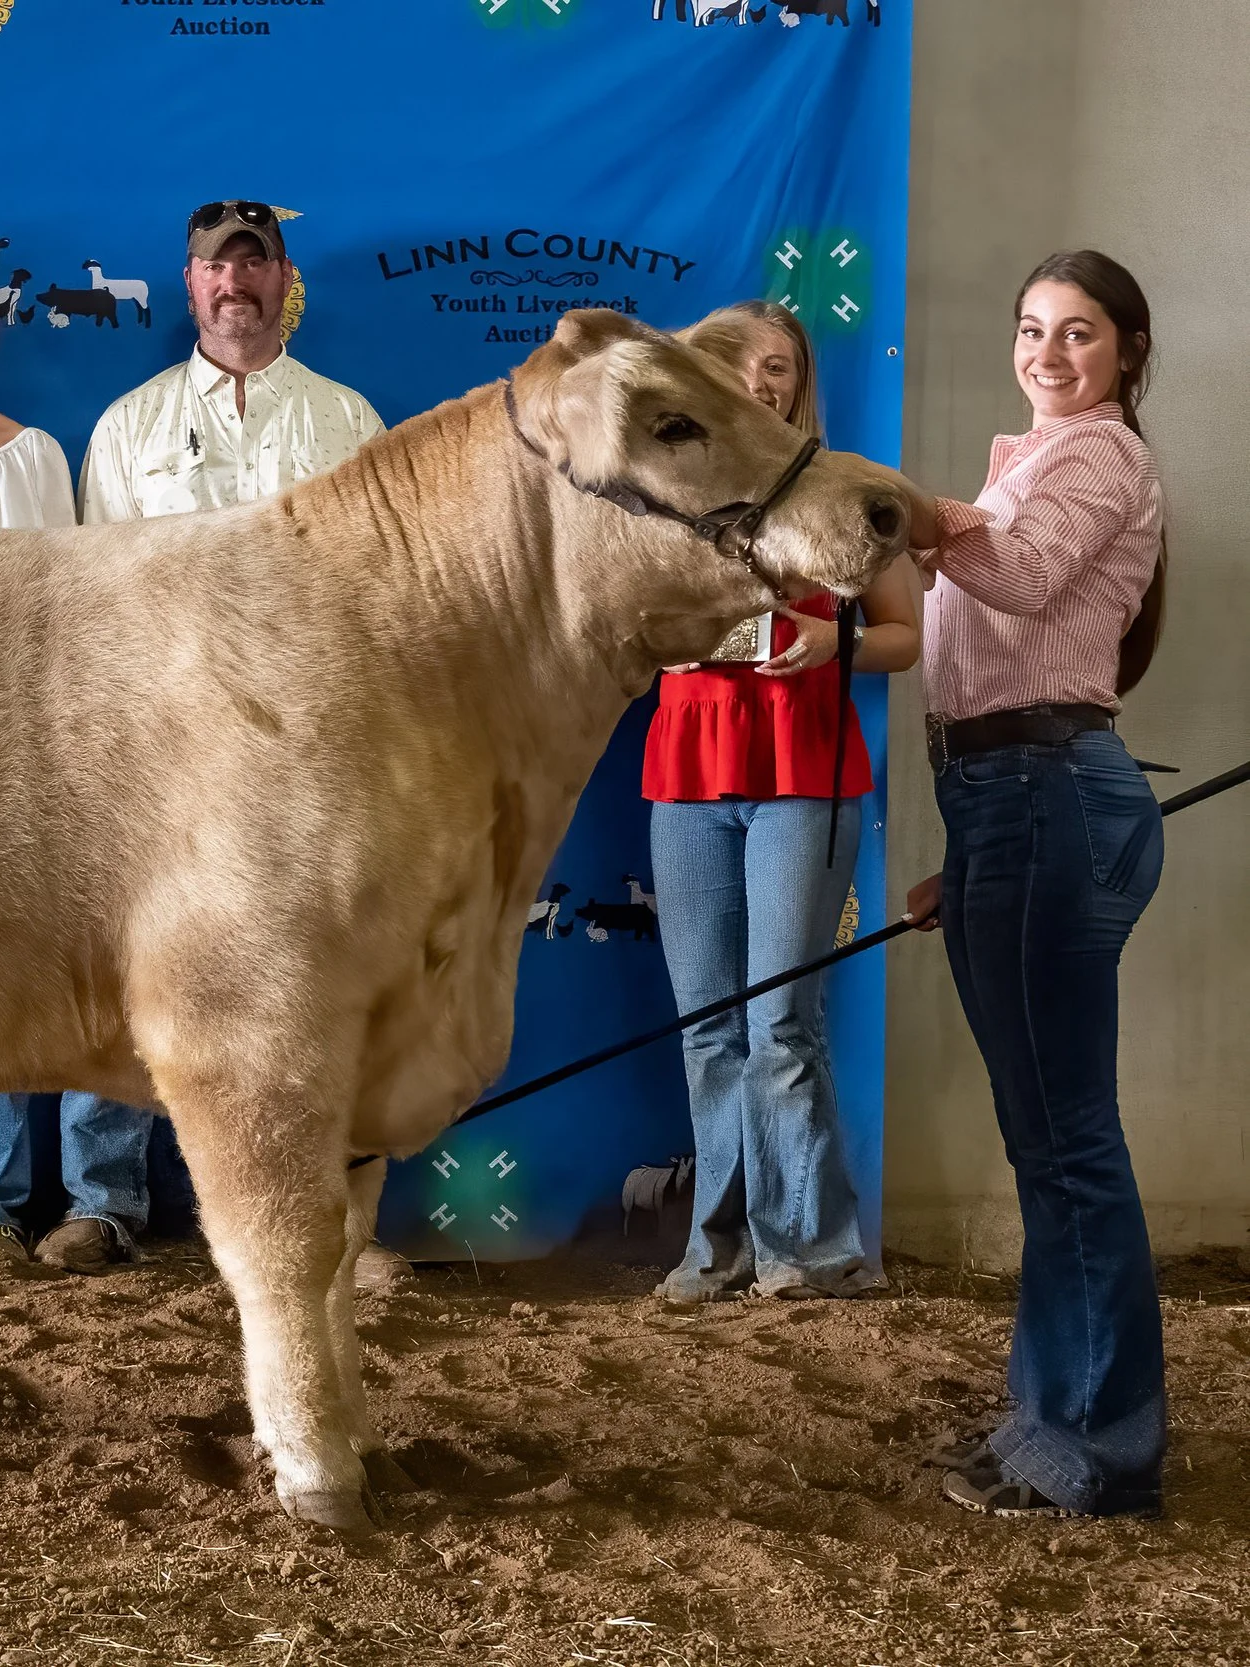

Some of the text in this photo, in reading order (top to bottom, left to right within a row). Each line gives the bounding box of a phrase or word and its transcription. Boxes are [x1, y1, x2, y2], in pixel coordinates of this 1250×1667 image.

[170, 17, 271, 36] Auction
[377, 228, 697, 283] LINN COUNTY
[430, 293, 507, 313] Youth
[484, 324, 553, 344] Aucti
